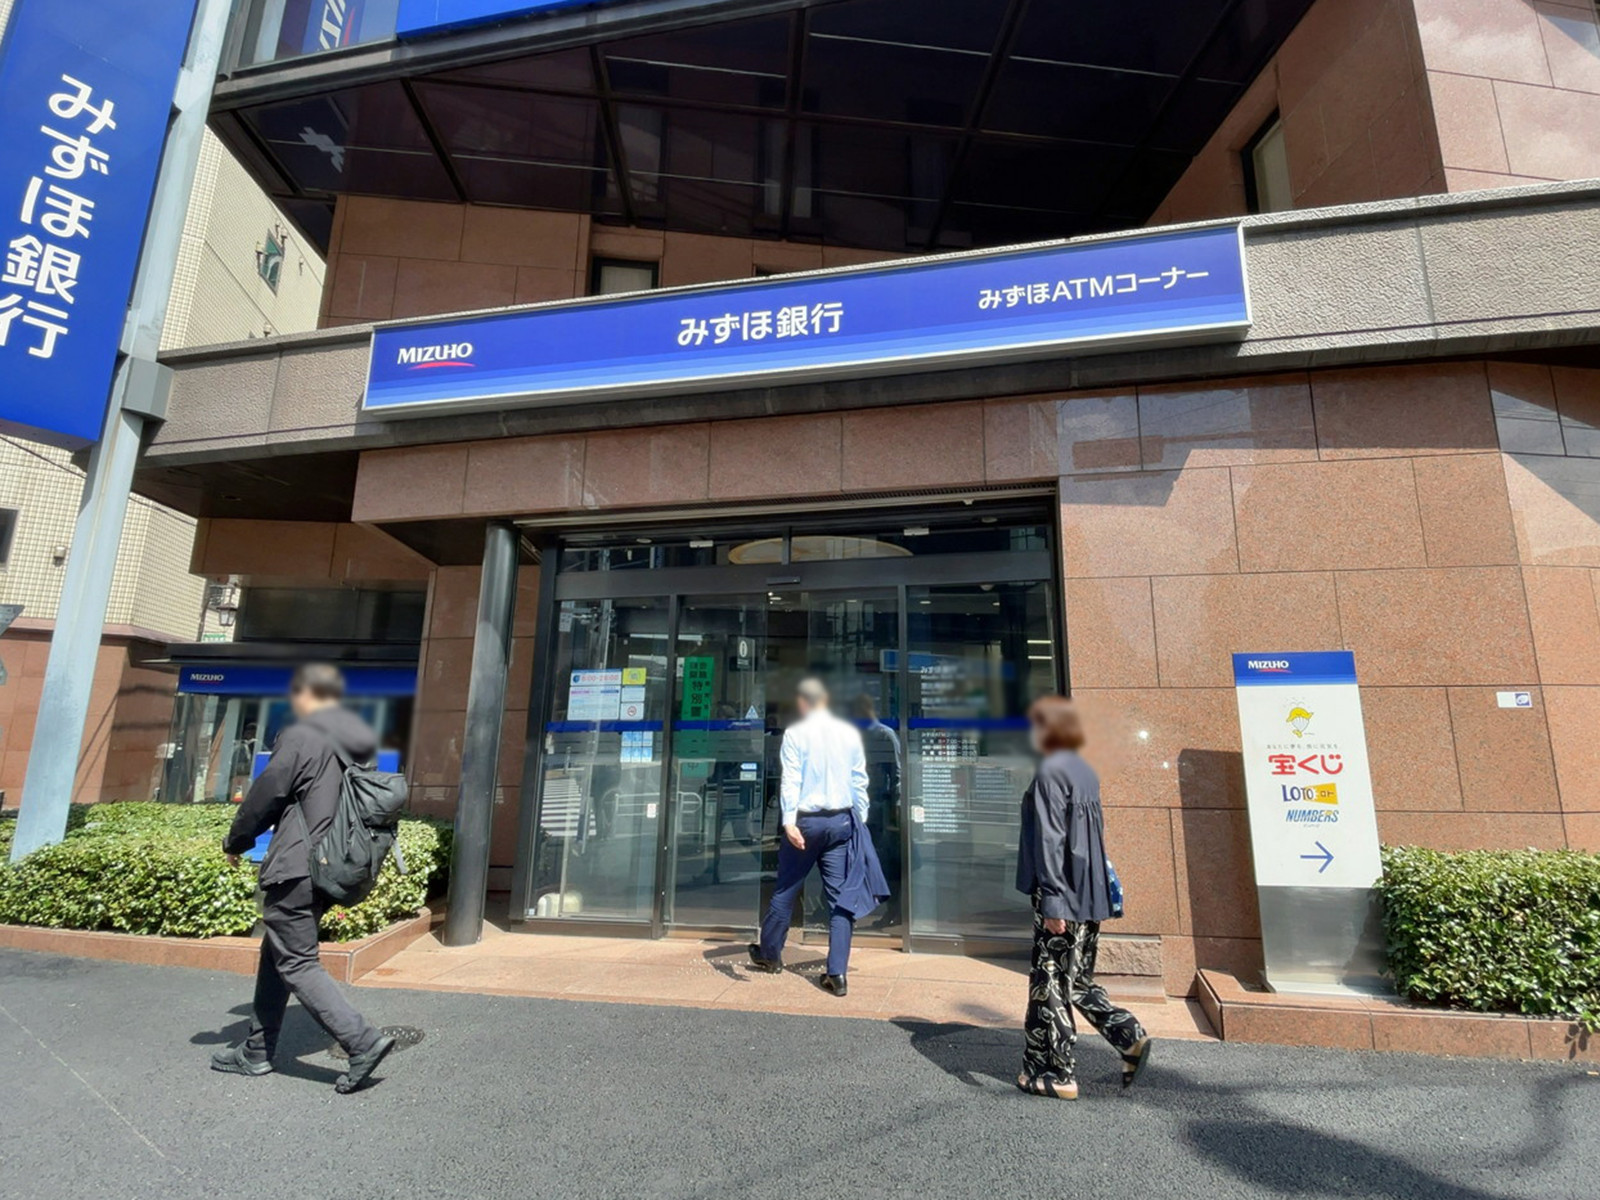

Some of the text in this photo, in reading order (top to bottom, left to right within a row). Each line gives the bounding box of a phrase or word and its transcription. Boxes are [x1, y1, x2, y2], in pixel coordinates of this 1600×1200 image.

[0, 73, 117, 359] みずほ銀行
[978, 266, 1209, 311] みずほATMコーナー
[677, 301, 844, 347] みずほ銀行
[397, 342, 474, 366] MIZUHO
[1248, 660, 1290, 670] MIZUHO
[190, 673, 224, 682] MIZUHO
[1268, 753, 1343, 775] 宝くじ
[1281, 784, 1314, 802] LOTO
[1285, 809, 1340, 823] NUMBERS
